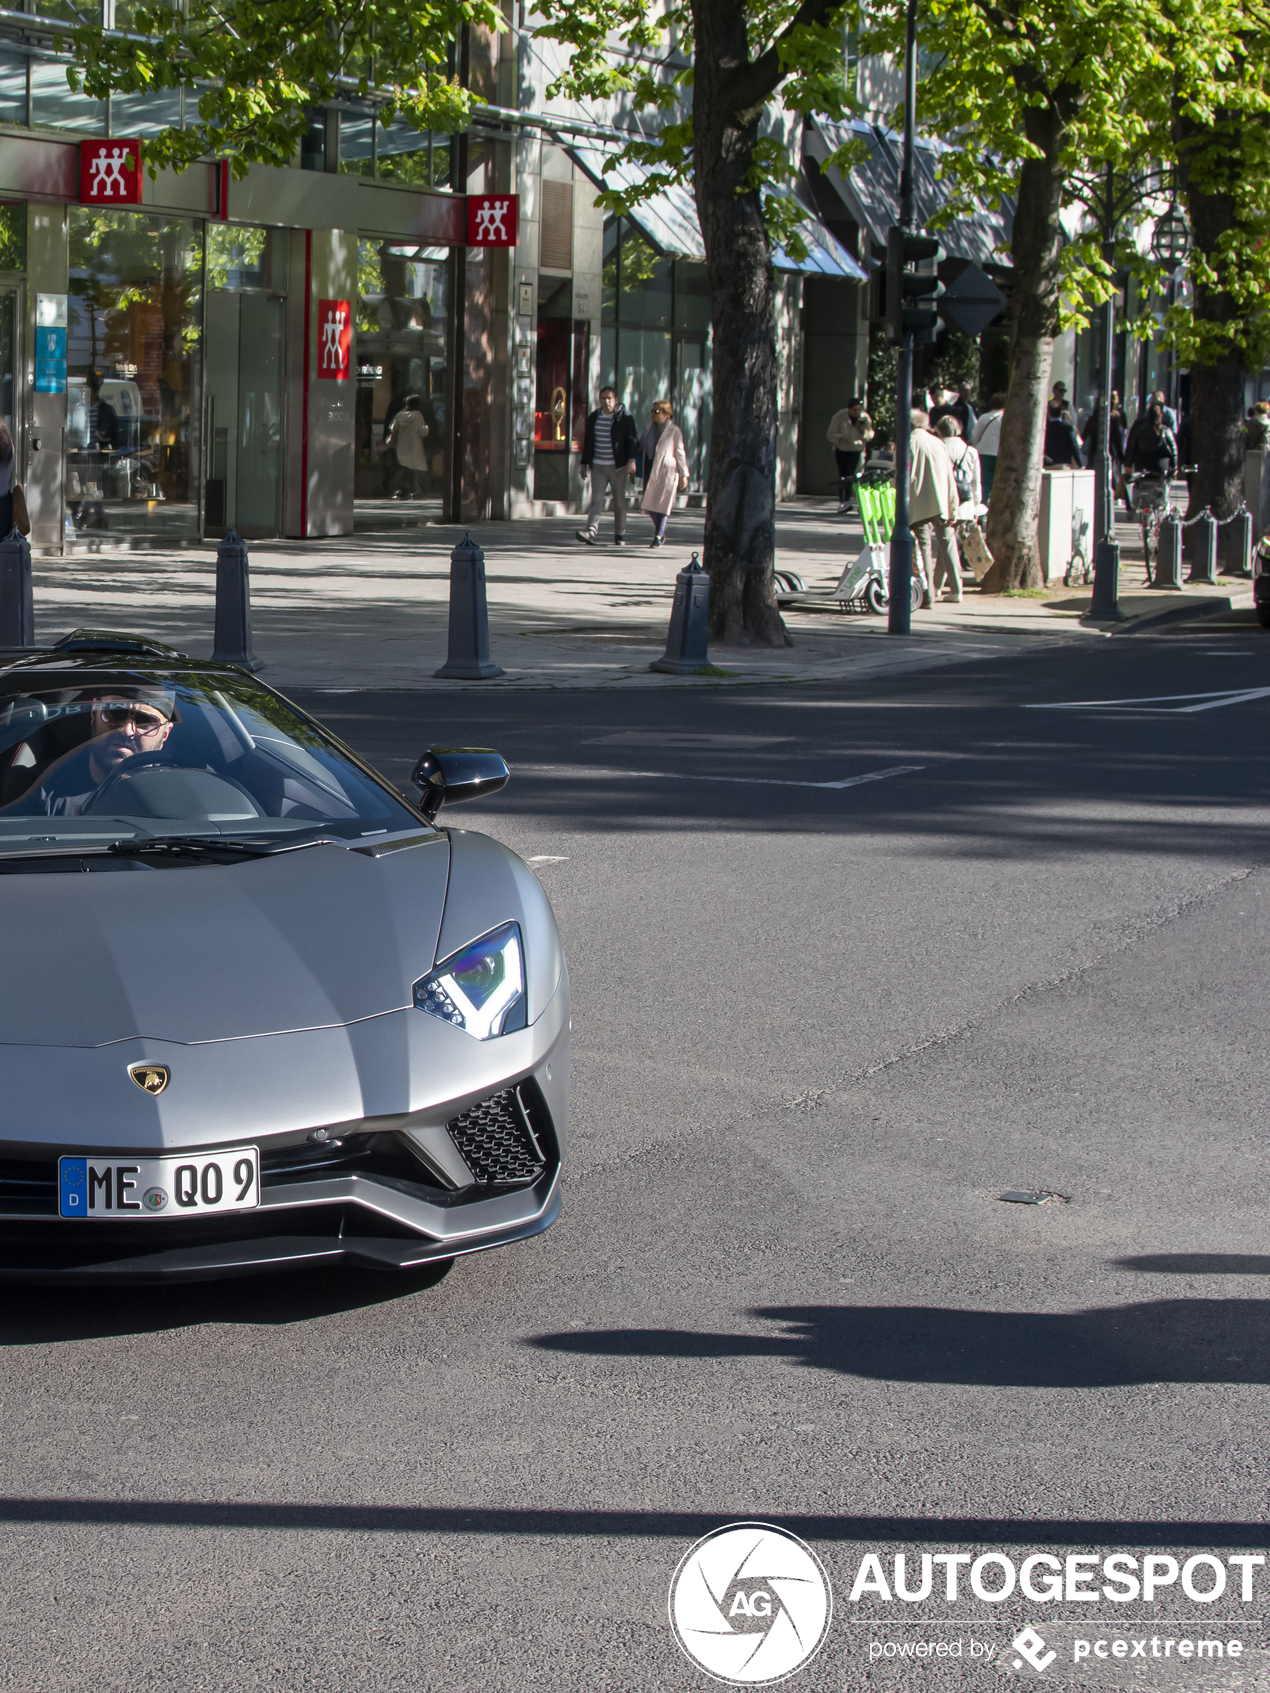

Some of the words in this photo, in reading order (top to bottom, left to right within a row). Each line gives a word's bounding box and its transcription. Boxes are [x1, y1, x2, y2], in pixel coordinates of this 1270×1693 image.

[844, 566, 863, 589] Lime
[88, 1165, 142, 1211] ME
[233, 1158, 255, 1202] 9
[69, 1193, 80, 1207] D
